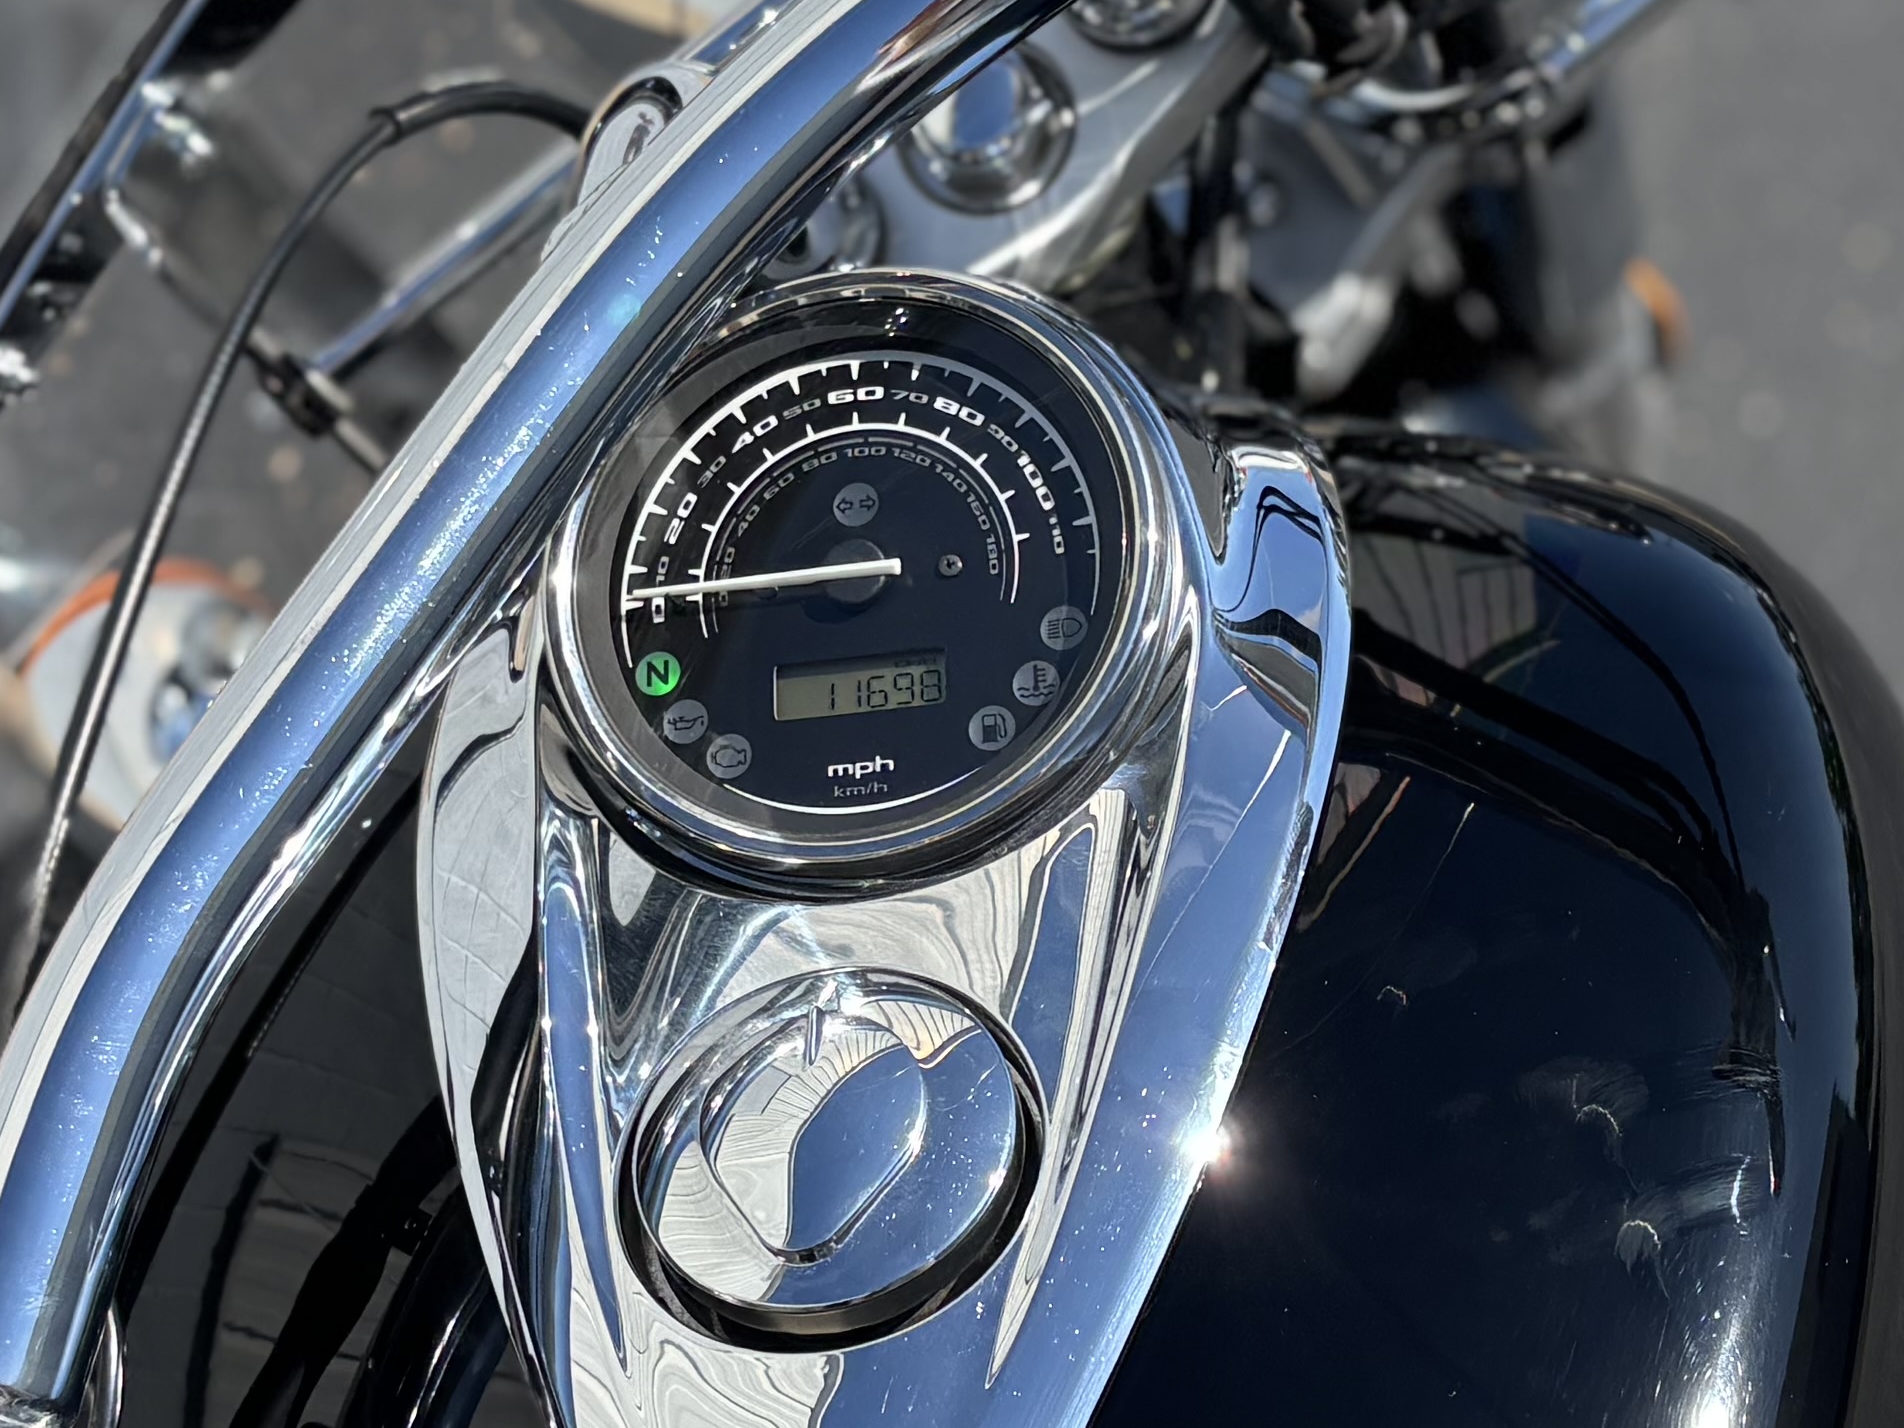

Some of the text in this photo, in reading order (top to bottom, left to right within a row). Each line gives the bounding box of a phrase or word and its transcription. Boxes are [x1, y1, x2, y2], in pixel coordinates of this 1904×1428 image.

[651, 386, 1065, 623] 0 10 20 30 40 50 60 70 80 90 100 110
[738, 504, 761, 537] 40
[763, 472, 795, 501] 60
[802, 451, 838, 472] 80
[843, 446, 887, 458] 100
[891, 448, 932, 467] 120
[934, 463, 969, 494] 140
[966, 494, 991, 530] 160
[985, 534, 999, 575] 180
[646, 659, 670, 687] N
[829, 669, 942, 711] 11698
[827, 755, 895, 779] mph
[833, 781, 888, 798] km/h
